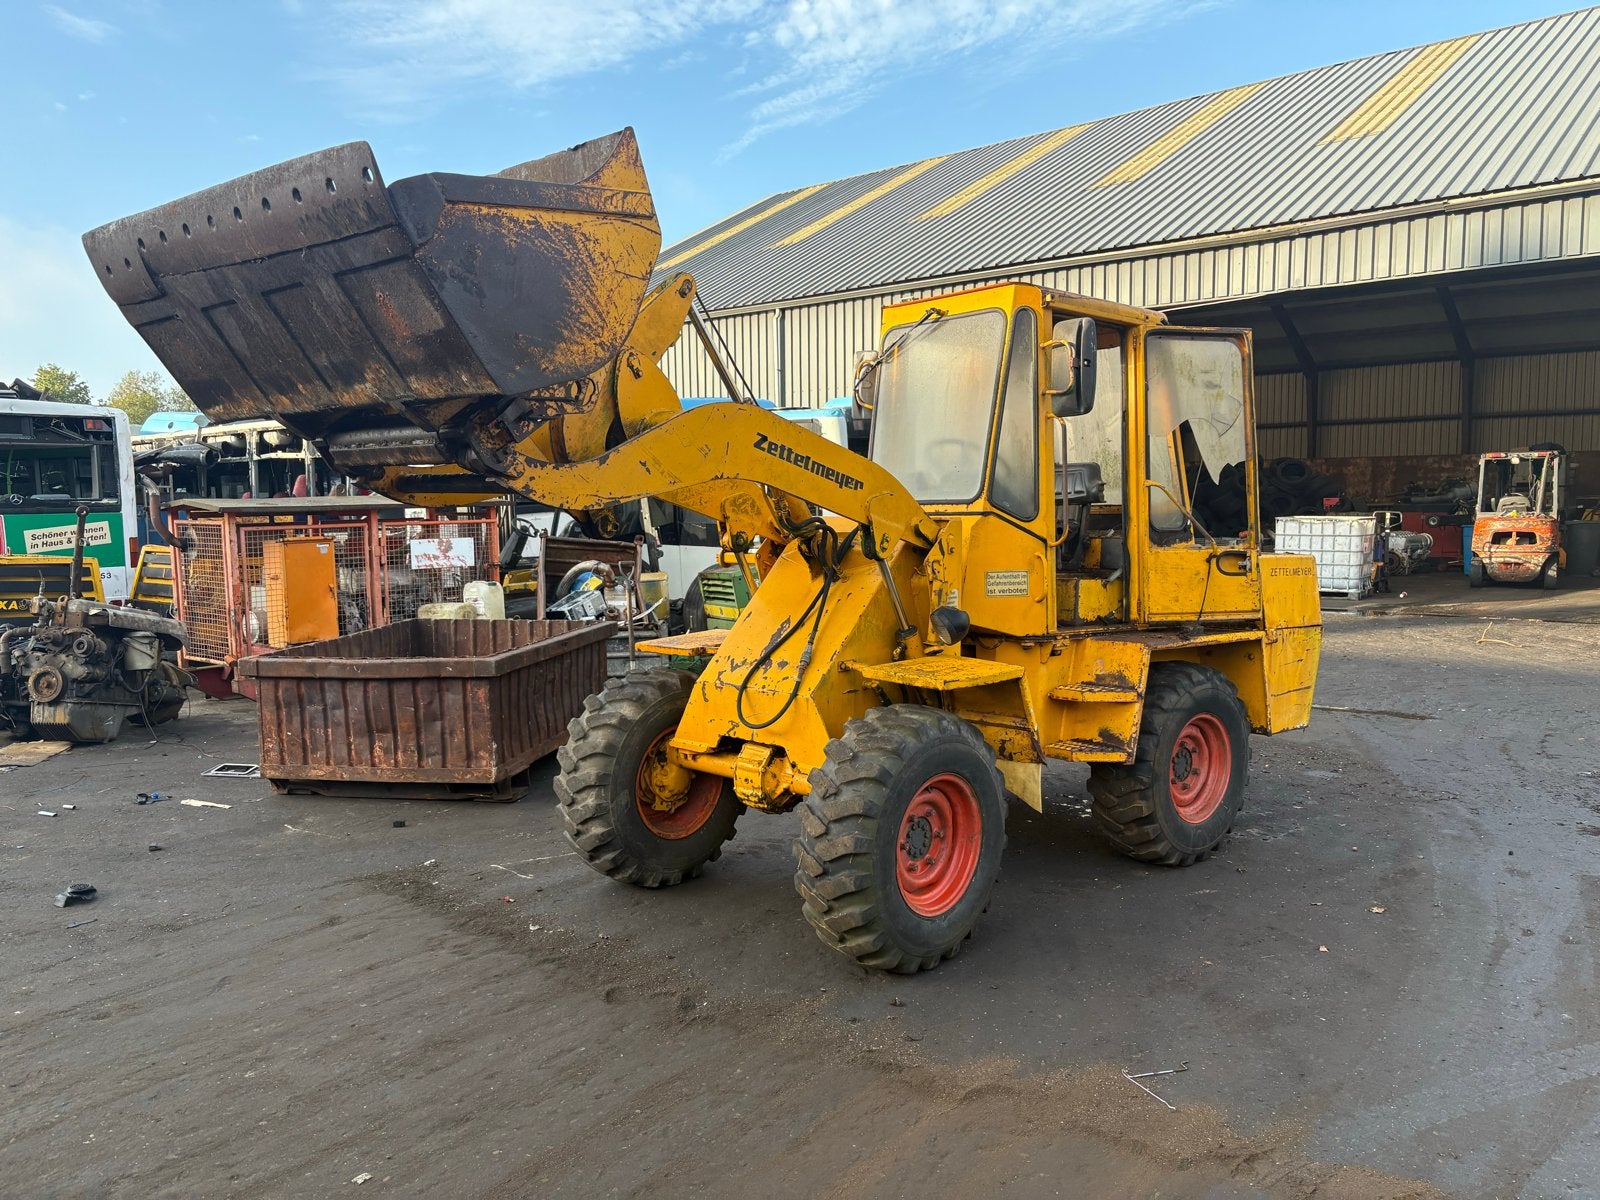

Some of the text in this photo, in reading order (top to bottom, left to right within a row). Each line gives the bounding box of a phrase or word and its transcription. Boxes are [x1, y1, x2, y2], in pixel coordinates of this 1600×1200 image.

[753, 432, 864, 490] Zettelmeyer
[31, 530, 68, 541] Schöner
[42, 539, 64, 548] Haus
